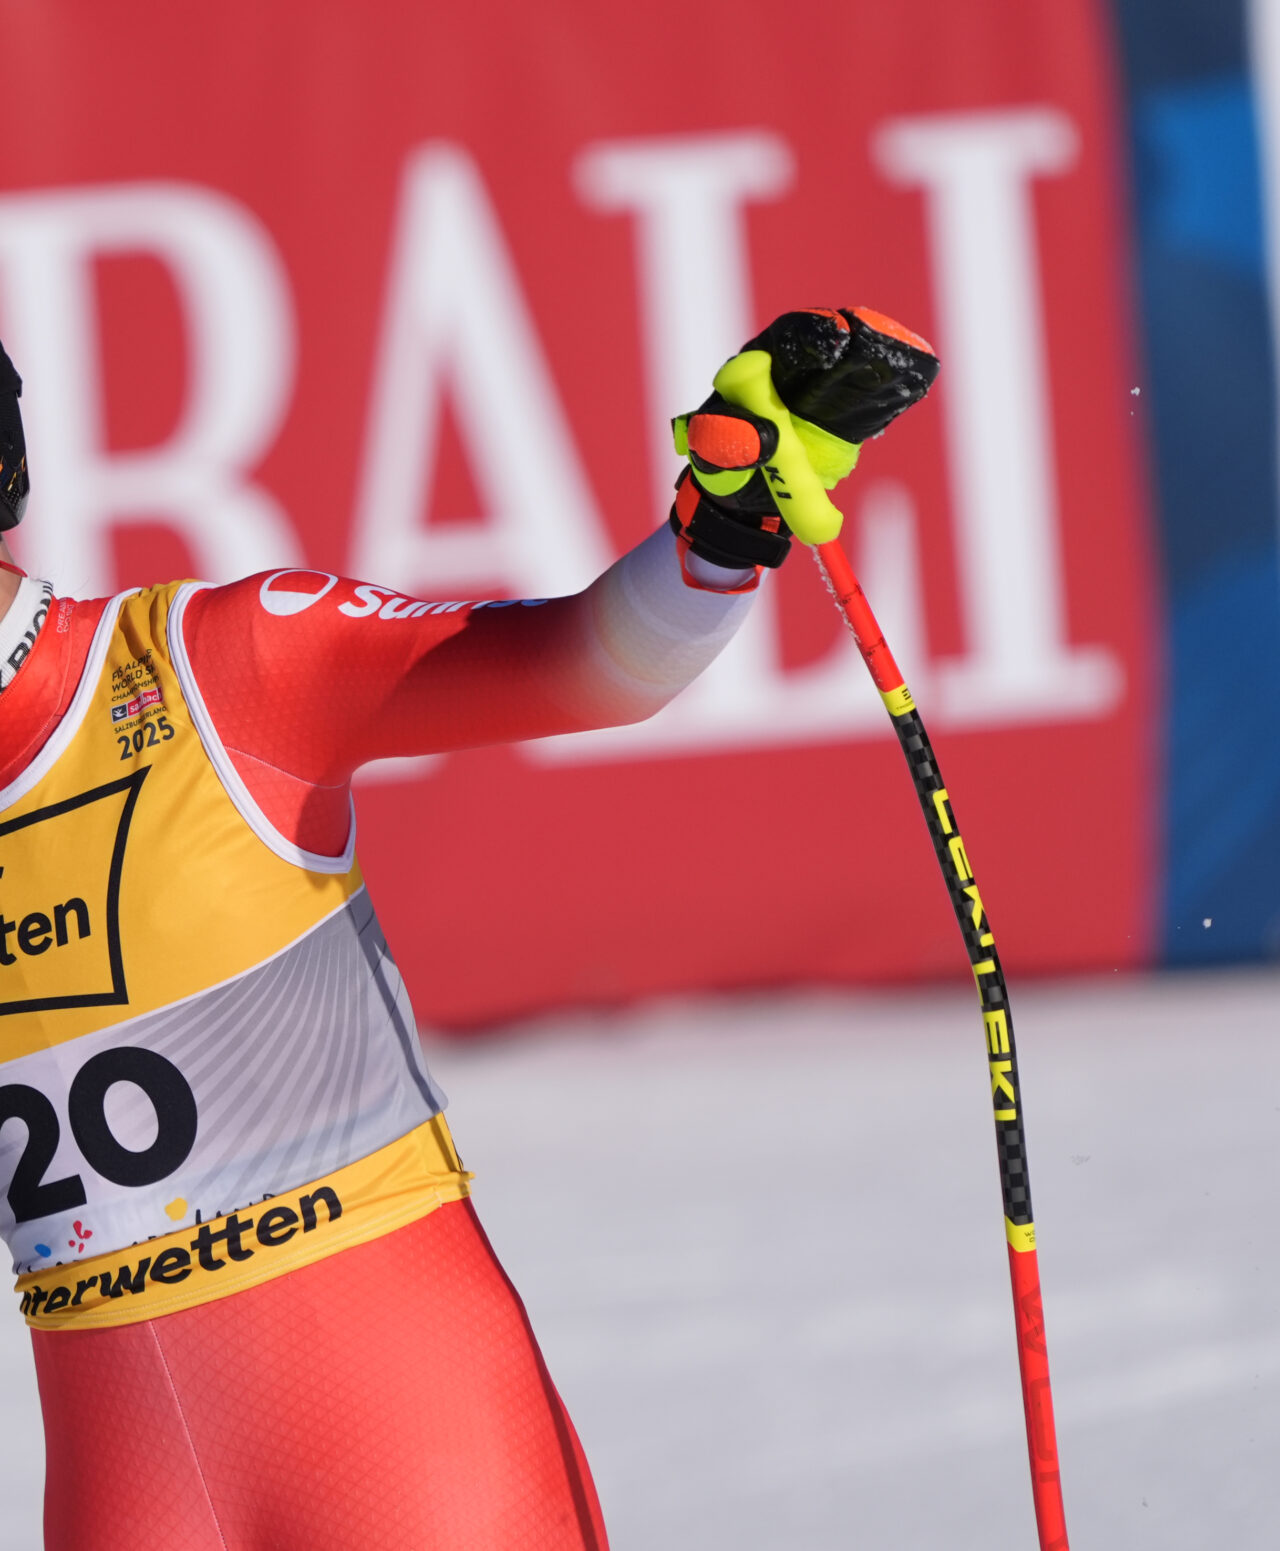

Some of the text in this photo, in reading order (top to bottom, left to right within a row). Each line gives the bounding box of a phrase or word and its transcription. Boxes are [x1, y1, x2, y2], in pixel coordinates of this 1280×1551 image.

[111, 669, 143, 693] WORLD
[117, 715, 175, 761] 2025
[19, 1186, 343, 1316] nterwetten
